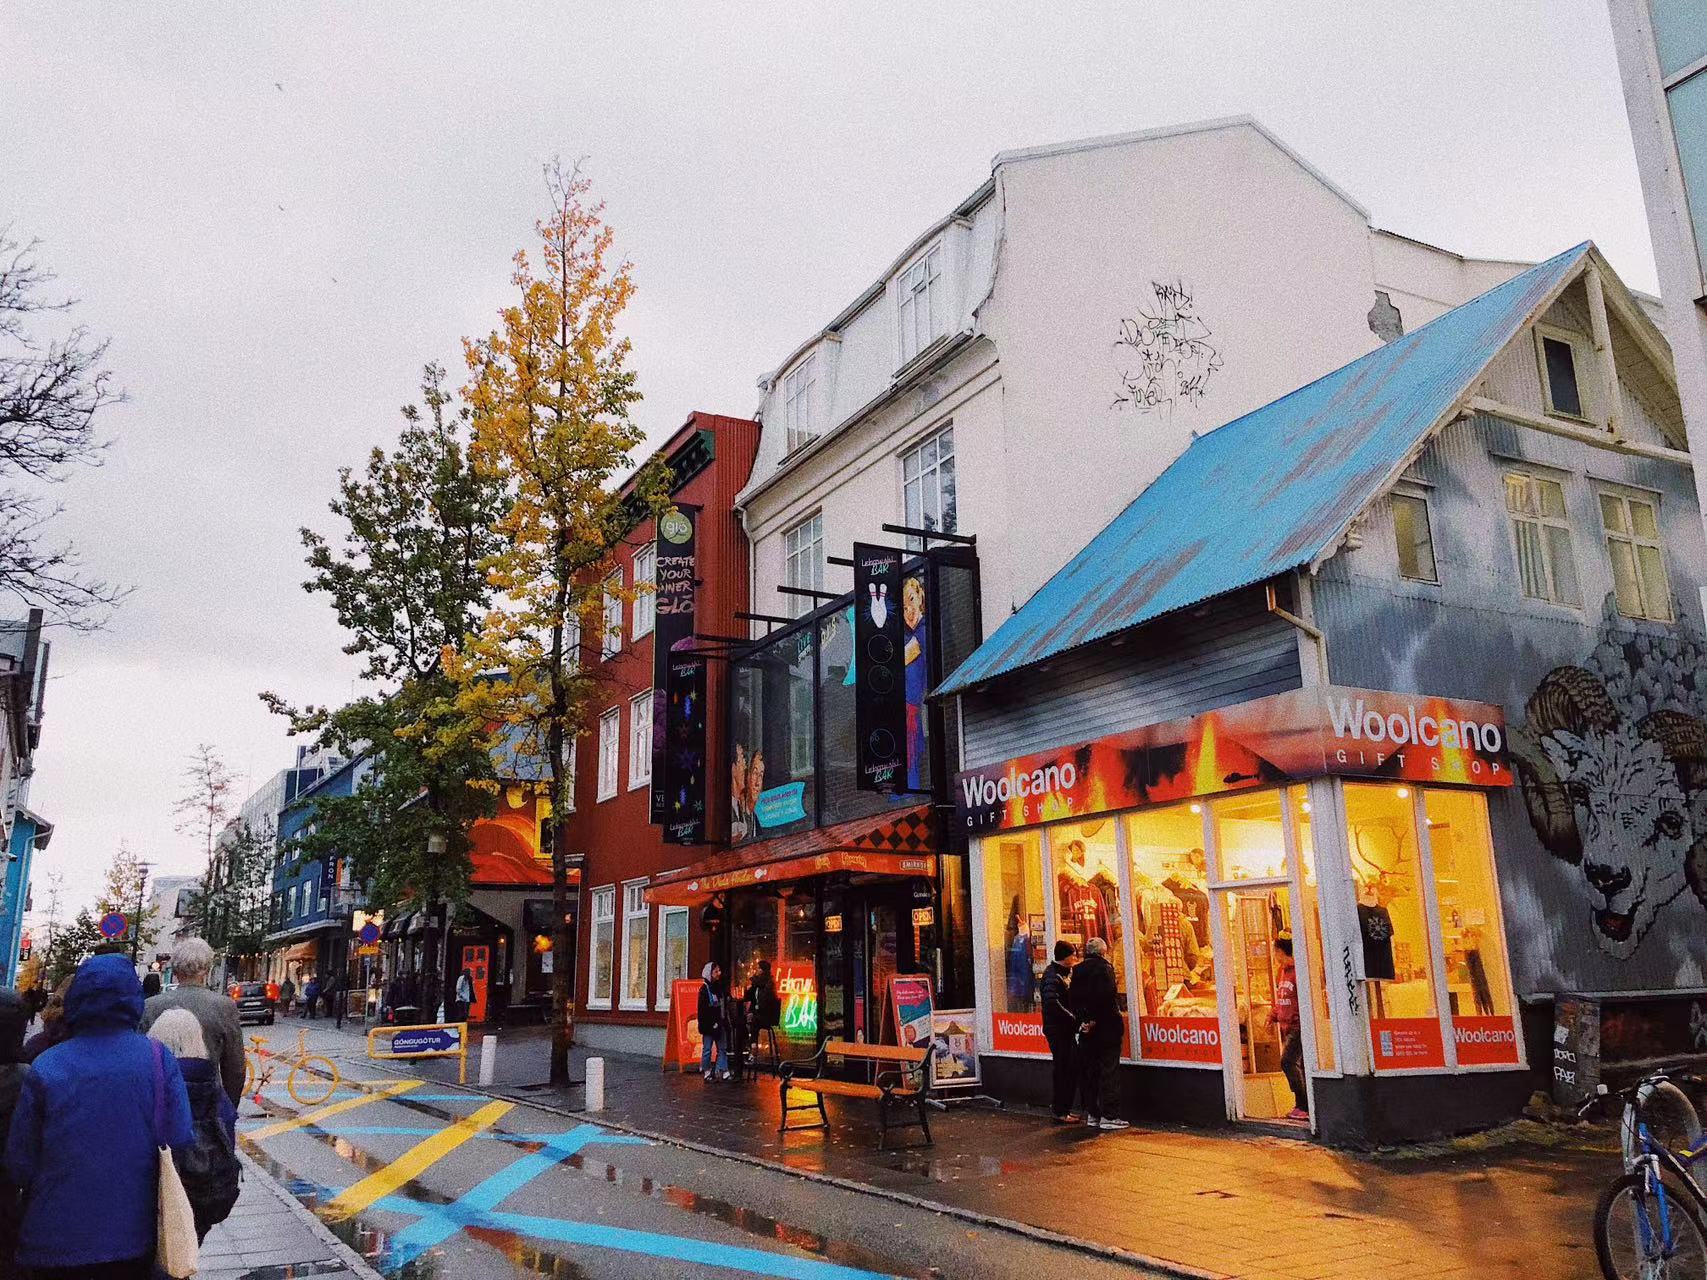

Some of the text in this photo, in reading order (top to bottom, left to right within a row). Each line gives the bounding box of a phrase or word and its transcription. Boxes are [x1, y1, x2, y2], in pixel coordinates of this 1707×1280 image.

[656, 556, 695, 568] CREATE
[660, 568, 692, 580] YOUR
[1327, 696, 1501, 752] Woolcano
[1336, 749, 1500, 775] GIFT SHOP
[962, 762, 1077, 809] Woolcano
[967, 797, 1073, 827] GIFT SHOP
[913, 911, 932, 923] OPEN
[1144, 1022, 1219, 1046] Woolcano
[1452, 1027, 1515, 1043] Woolcano
